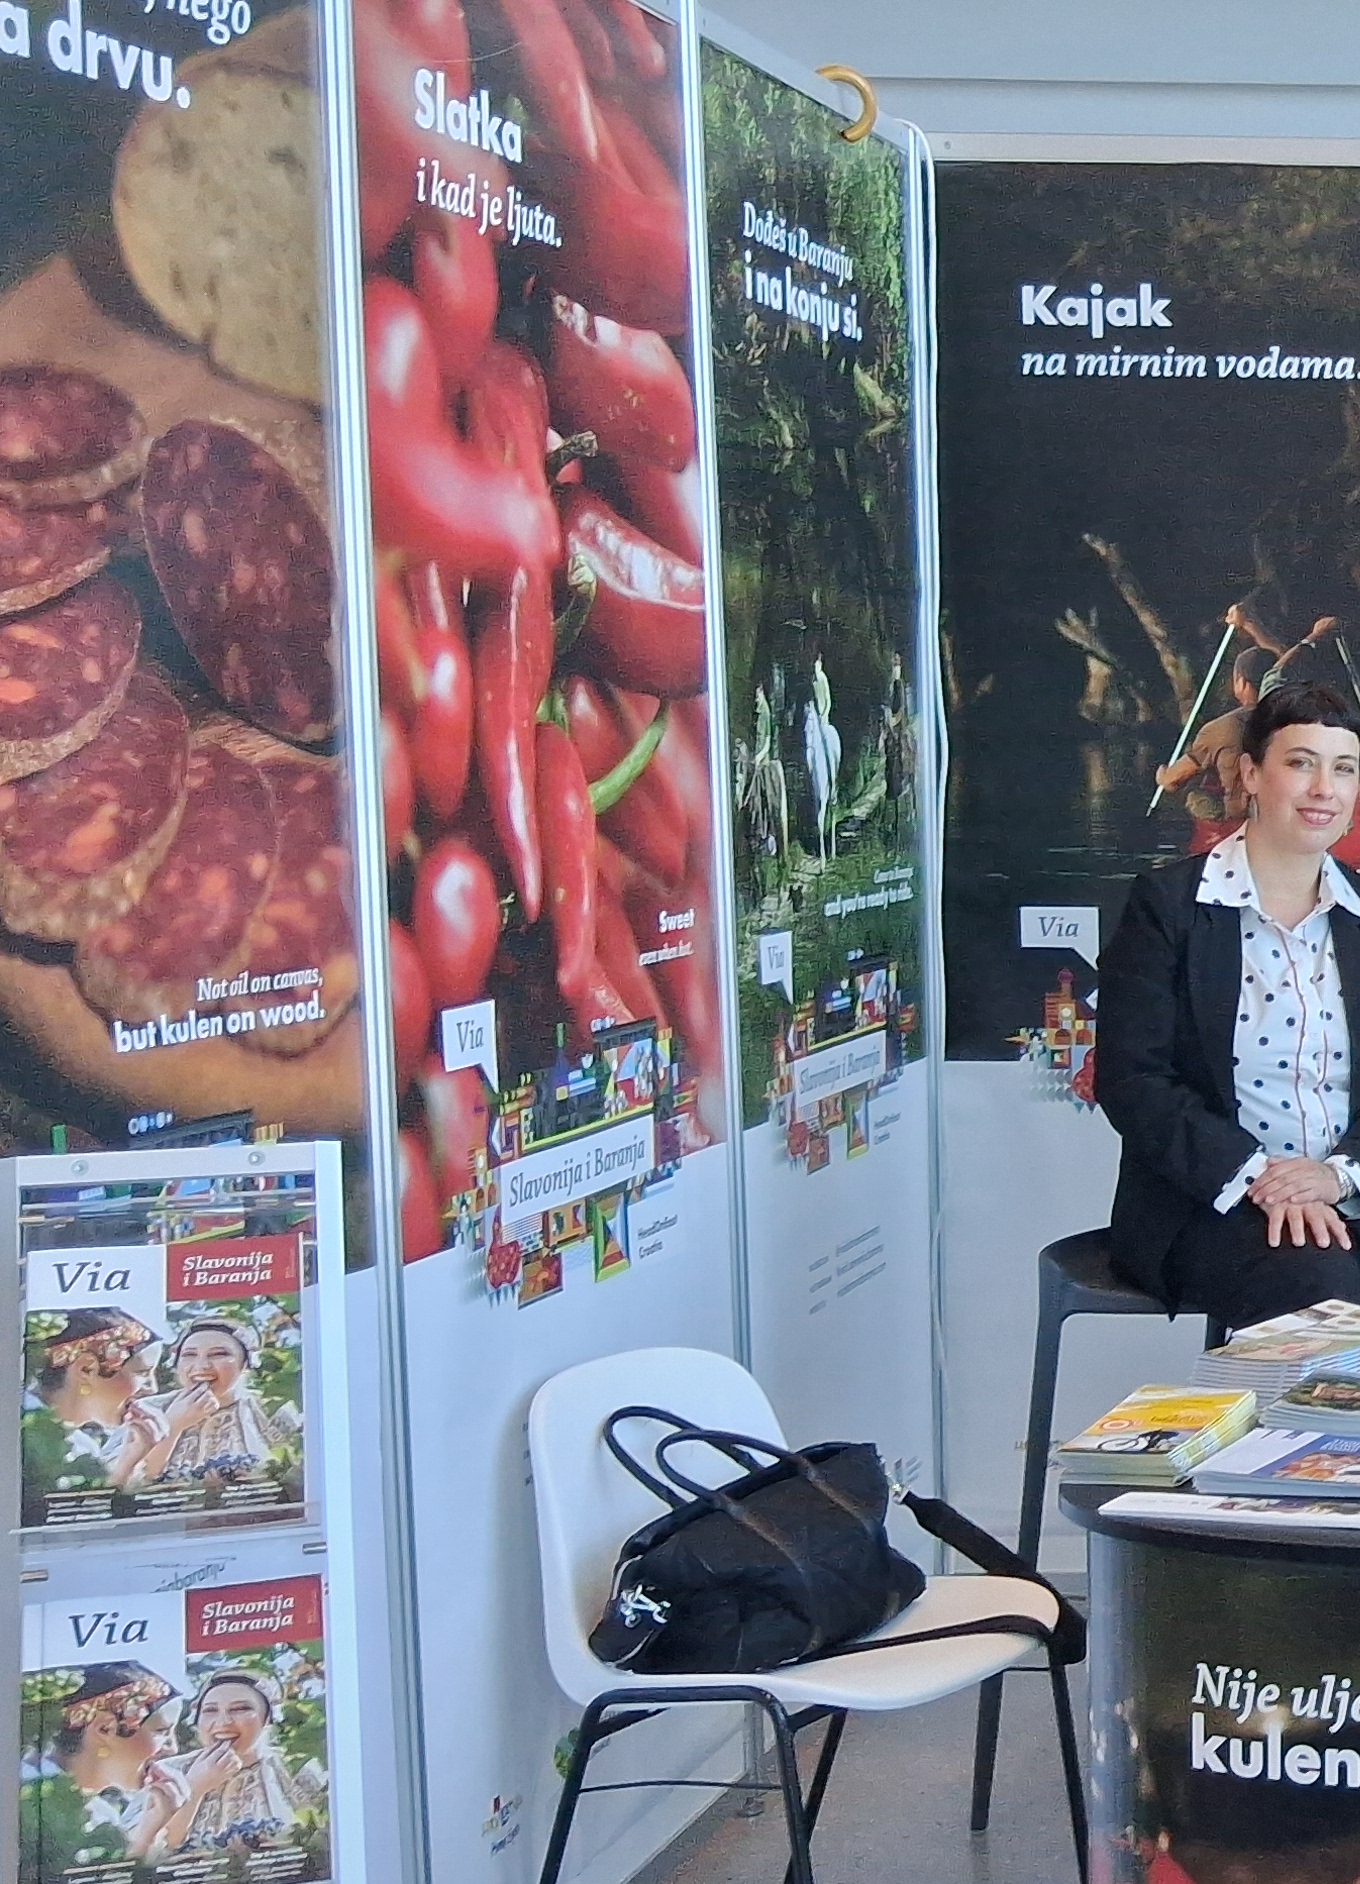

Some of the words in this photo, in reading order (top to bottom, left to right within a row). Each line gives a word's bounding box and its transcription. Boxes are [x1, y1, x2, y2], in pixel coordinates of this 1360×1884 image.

[48, 0, 191, 109] drvu.
[414, 68, 523, 163] Slatka
[416, 157, 426, 202] i
[431, 159, 476, 218] kad
[478, 180, 503, 236] je
[506, 185, 563, 248] ljuta.
[742, 201, 787, 253] Dođeš
[787, 231, 798, 259] u
[798, 226, 854, 288] Baranju
[744, 249, 753, 300] i
[755, 271, 783, 311] na
[785, 266, 840, 342] konju
[842, 293, 863, 342] si.
[1020, 283, 1173, 339] Kajak
[1020, 351, 1067, 377] na
[1074, 345, 1208, 379] mirnim
[659, 908, 695, 933] Sweet
[1038, 915, 1080, 939] Via
[196, 976, 228, 1002] Not
[229, 970, 249, 997] oil
[250, 976, 272, 994] on
[273, 967, 324, 991] canvas,
[113, 1020, 158, 1053] but
[160, 1008, 224, 1046] kulen
[226, 1010, 257, 1034] on
[260, 990, 327, 1028] wood.
[456, 1019, 485, 1053] Via
[508, 1157, 583, 1209] Slavonija
[586, 1153, 592, 1181] i
[594, 1135, 646, 1190] Baranja
[52, 1260, 132, 1294] Via
[182, 1250, 274, 1272] Slavonija
[183, 1272, 190, 1287] i
[195, 1267, 273, 1287] Baranja
[201, 1593, 296, 1620] Slavonija
[202, 1621, 209, 1637] i
[216, 1611, 294, 1636] Baranja
[67, 1611, 150, 1649] Via
[1191, 1662, 1281, 1718] Nije
